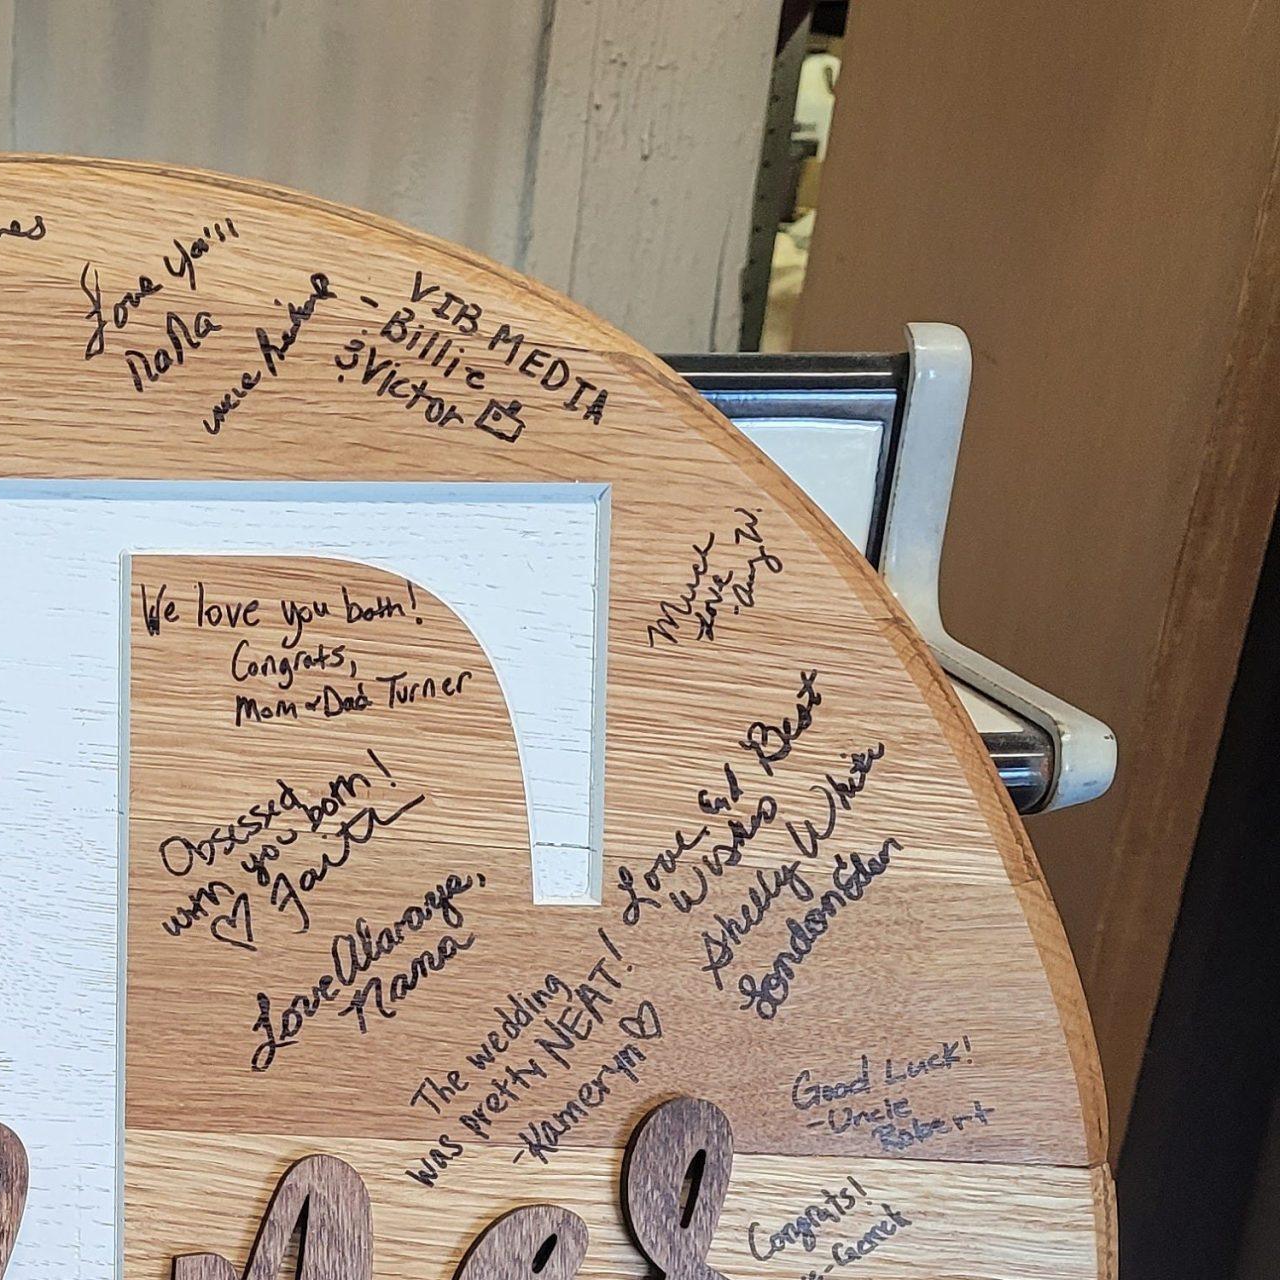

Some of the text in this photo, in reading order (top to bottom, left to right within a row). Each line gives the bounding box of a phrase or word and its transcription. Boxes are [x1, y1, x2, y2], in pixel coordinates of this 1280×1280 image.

[81, 262, 163, 361] Love
[410, 271, 482, 335] VIB
[488, 324, 609, 425] MEDIA
[140, 580, 423, 649] We love you both!
[235, 671, 472, 726] Mom Dad Turner
[738, 669, 822, 776] Best
[241, 828, 298, 886] you
[702, 860, 813, 990] Shelly
[405, 928, 633, 1187] was pretty NEAT!
[410, 974, 573, 1114] The wedding
[791, 1054, 870, 1110] Good
[872, 1101, 995, 1150] Robert
[748, 1176, 872, 1261] Congrats!
